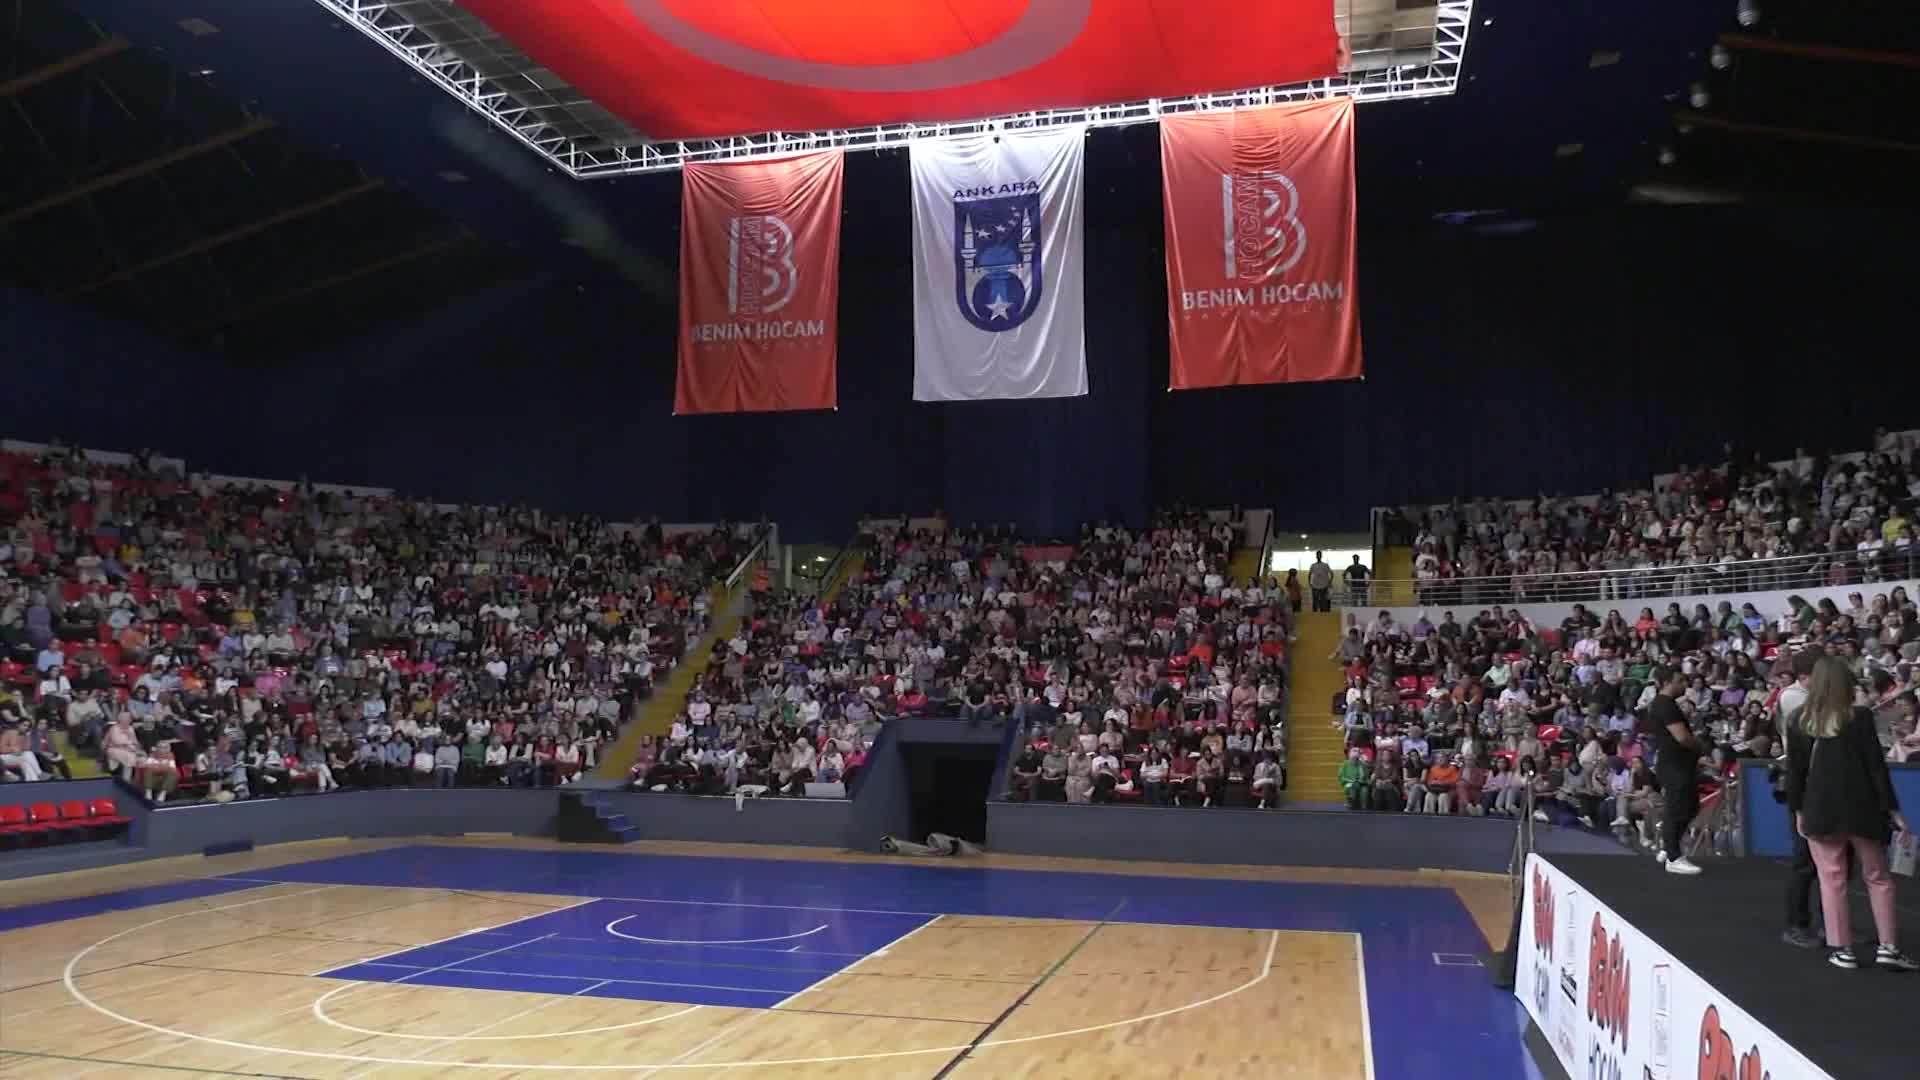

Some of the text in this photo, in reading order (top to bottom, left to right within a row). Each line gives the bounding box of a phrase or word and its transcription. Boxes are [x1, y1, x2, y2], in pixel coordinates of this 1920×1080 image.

[952, 180, 1040, 199] ANKARA
[1261, 280, 1344, 305] HOCAM
[756, 319, 825, 340] HOCAM
